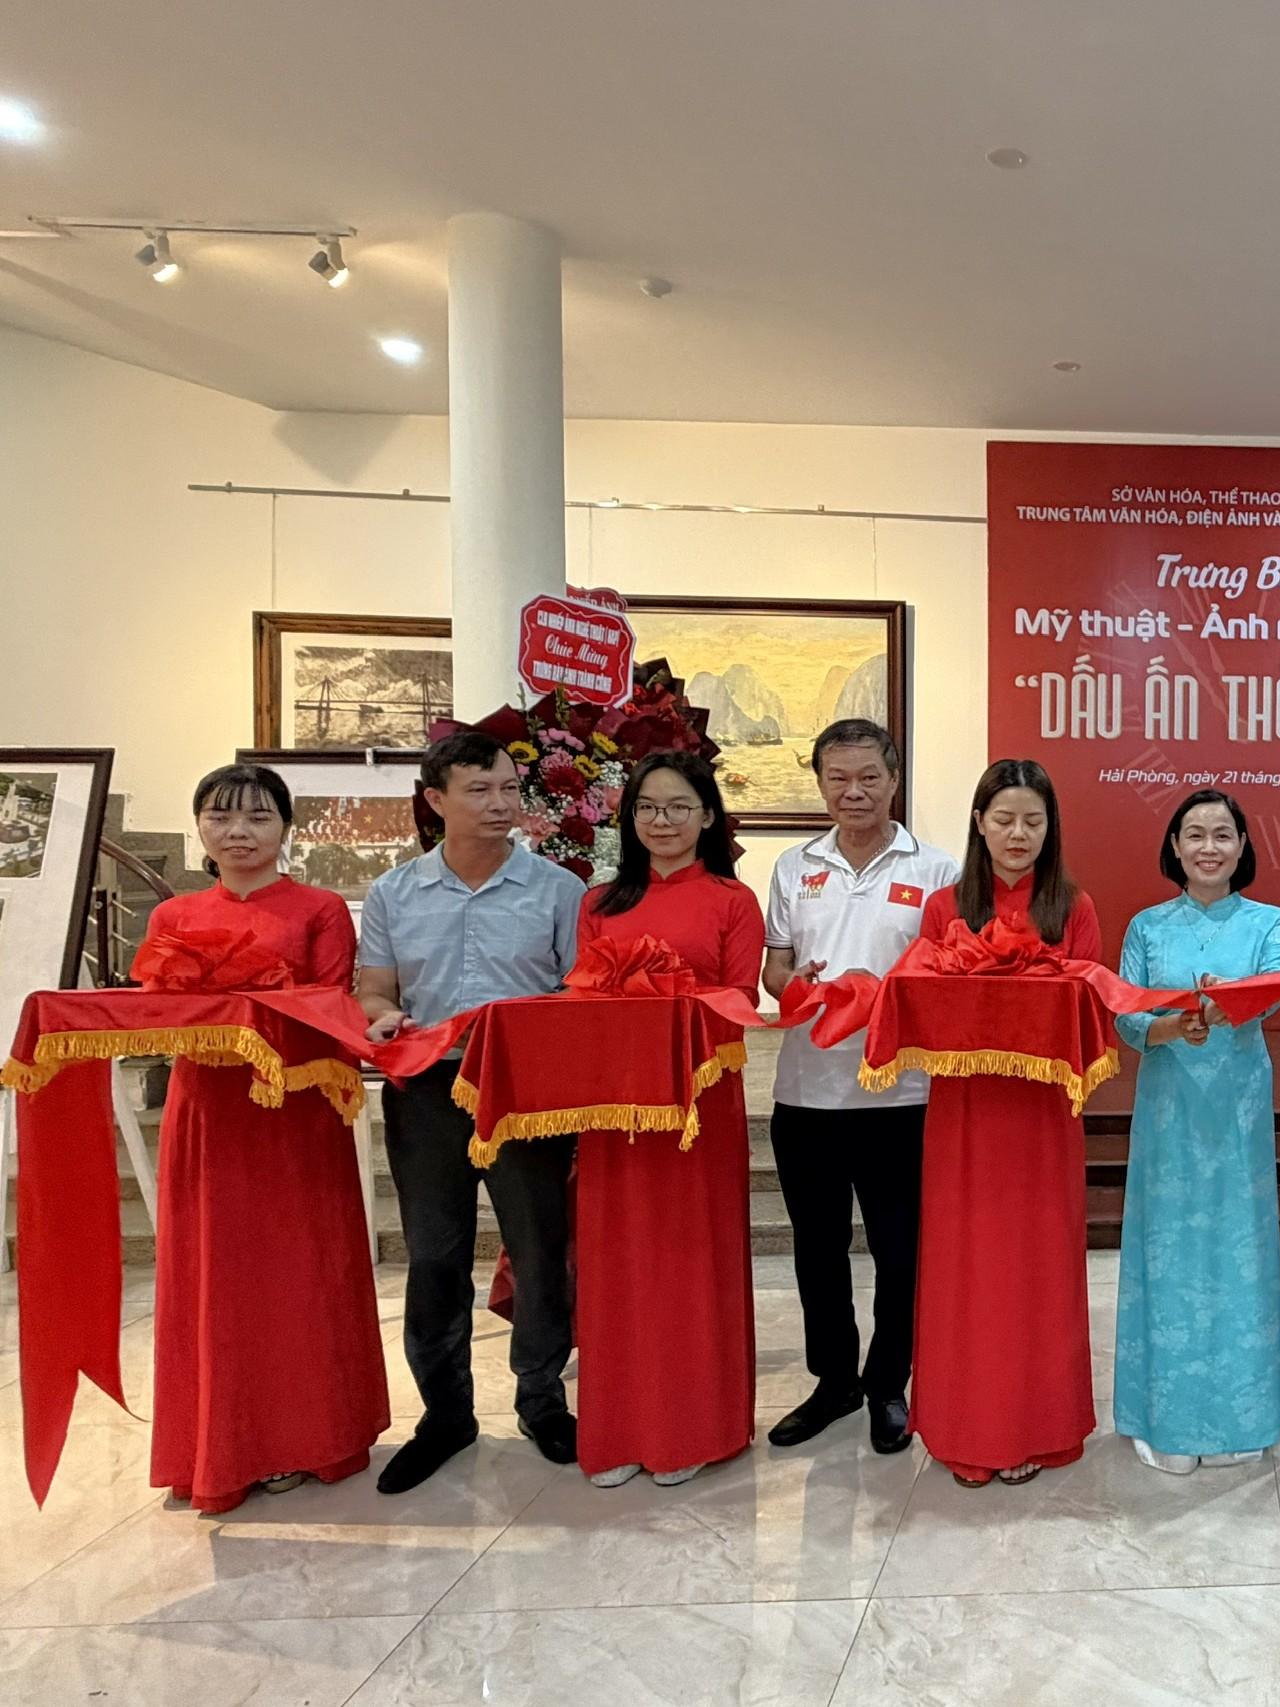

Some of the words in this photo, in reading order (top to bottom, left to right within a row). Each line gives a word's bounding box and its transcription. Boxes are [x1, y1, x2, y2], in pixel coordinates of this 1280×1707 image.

[1112, 485, 1133, 503] SỞ
[1135, 487, 1166, 504] VĂN
[1169, 488, 1207, 506] HÓA,
[1209, 487, 1238, 505] THỂ
[1016, 505, 1070, 522] TRUNG
[1073, 506, 1106, 523] TÂM
[1109, 506, 1141, 524] VĂN
[1145, 508, 1183, 527] HÓA,
[1186, 509, 1223, 529] ĐIỆN
[1226, 508, 1260, 527] ẢNH
[1156, 553, 1248, 599] Trưng
[1015, 608, 1071, 641] Mỹ
[1079, 609, 1171, 643] thuật
[1200, 603, 1268, 640] Ảnh
[1145, 655, 1199, 740] ẤN
[1099, 768, 1125, 782] Hải
[1127, 769, 1179, 785] Phòng,
[1183, 770, 1220, 786] ngày
[1222, 771, 1238, 783] 21
